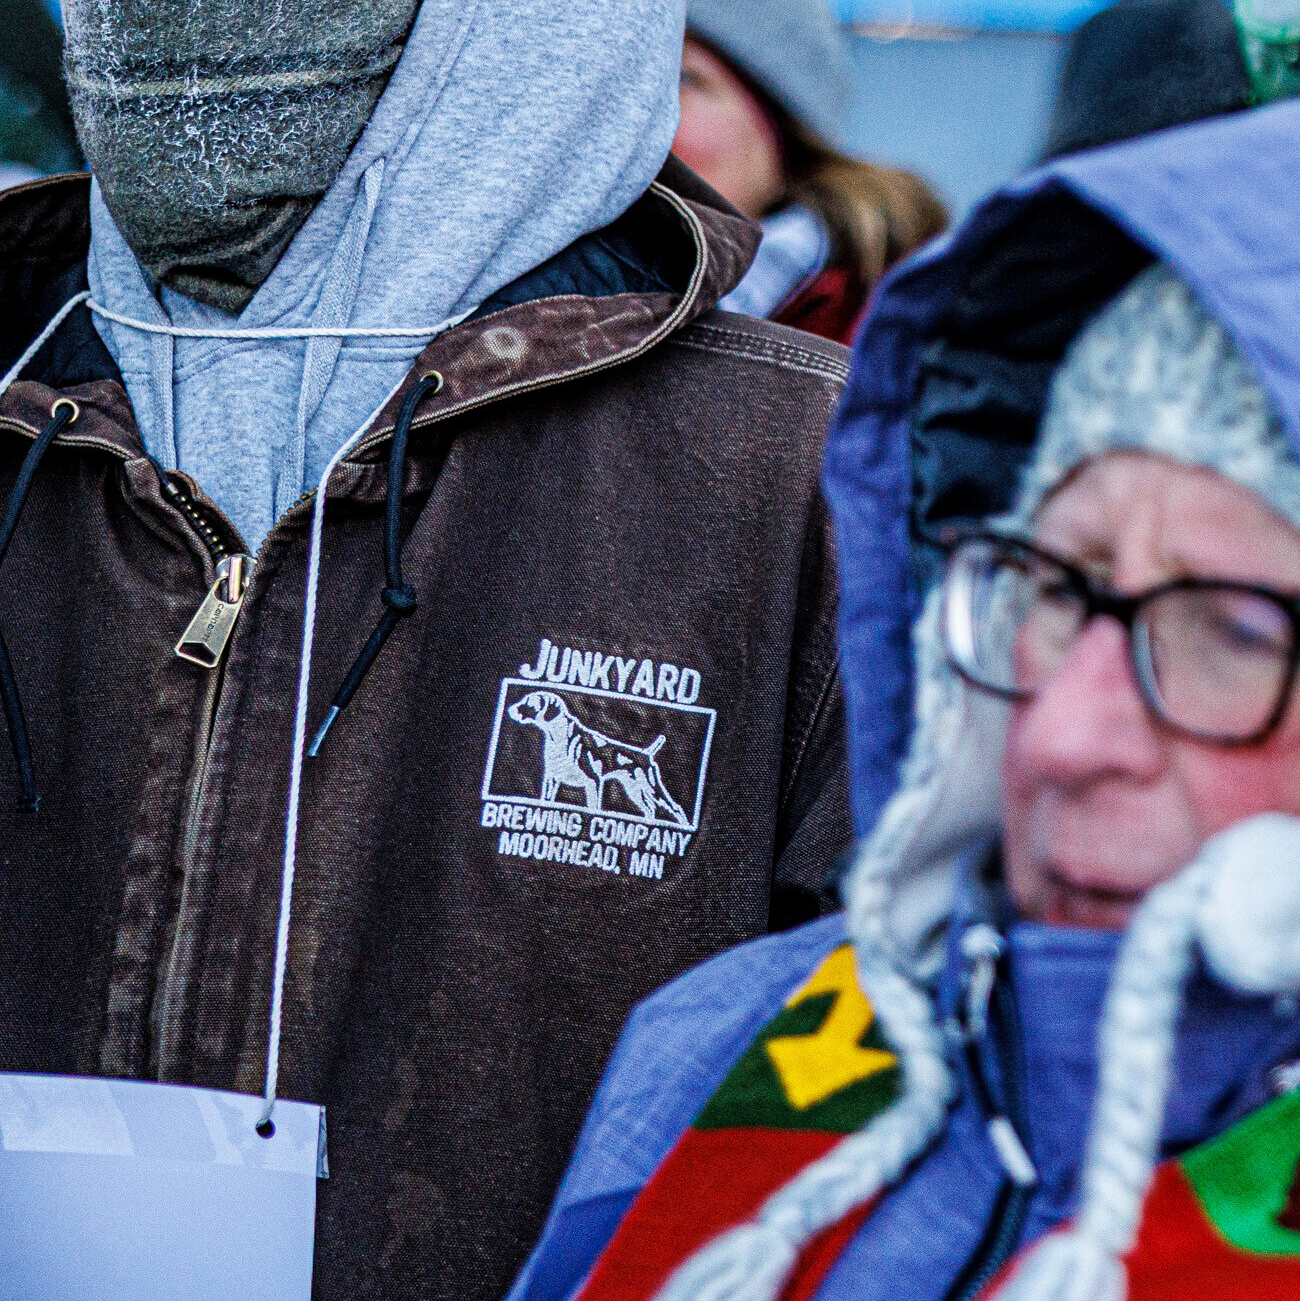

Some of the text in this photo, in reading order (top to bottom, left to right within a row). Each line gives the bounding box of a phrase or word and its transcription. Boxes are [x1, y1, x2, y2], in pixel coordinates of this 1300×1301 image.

[519, 638, 702, 704] JUNKYARD
[481, 803, 692, 857] BREWING COMPANY
[498, 831, 665, 880] MOORHEAD, MN
